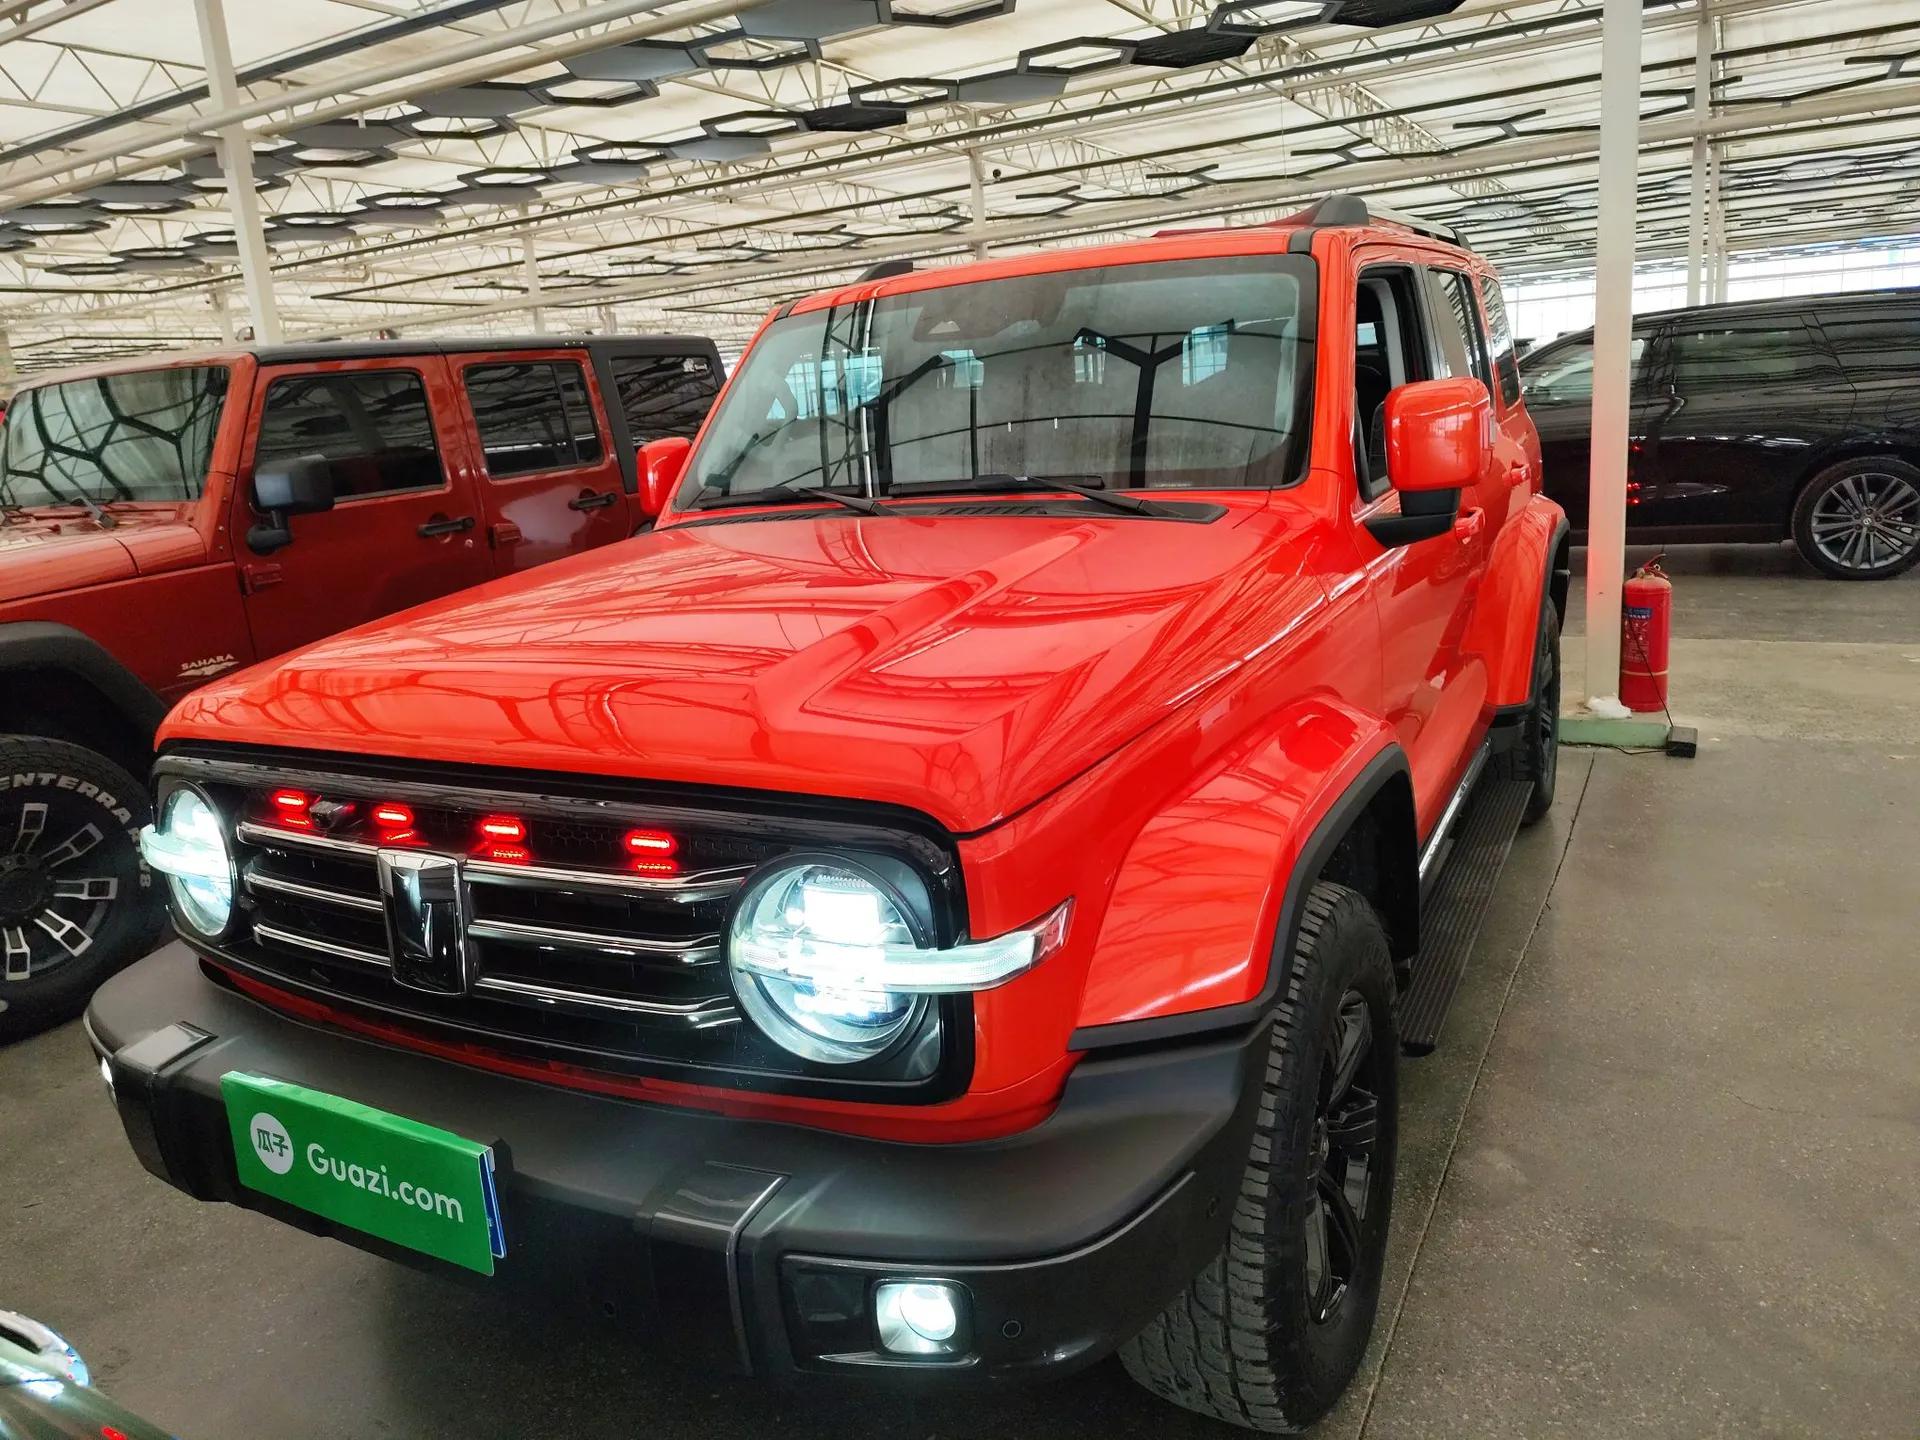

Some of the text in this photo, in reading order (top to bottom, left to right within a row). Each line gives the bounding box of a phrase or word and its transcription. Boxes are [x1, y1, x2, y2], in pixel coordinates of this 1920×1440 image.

[181, 653, 234, 671] SAHARA
[256, 1128, 288, 1157] 瓜子
[307, 1143, 464, 1223] Guazi.com
